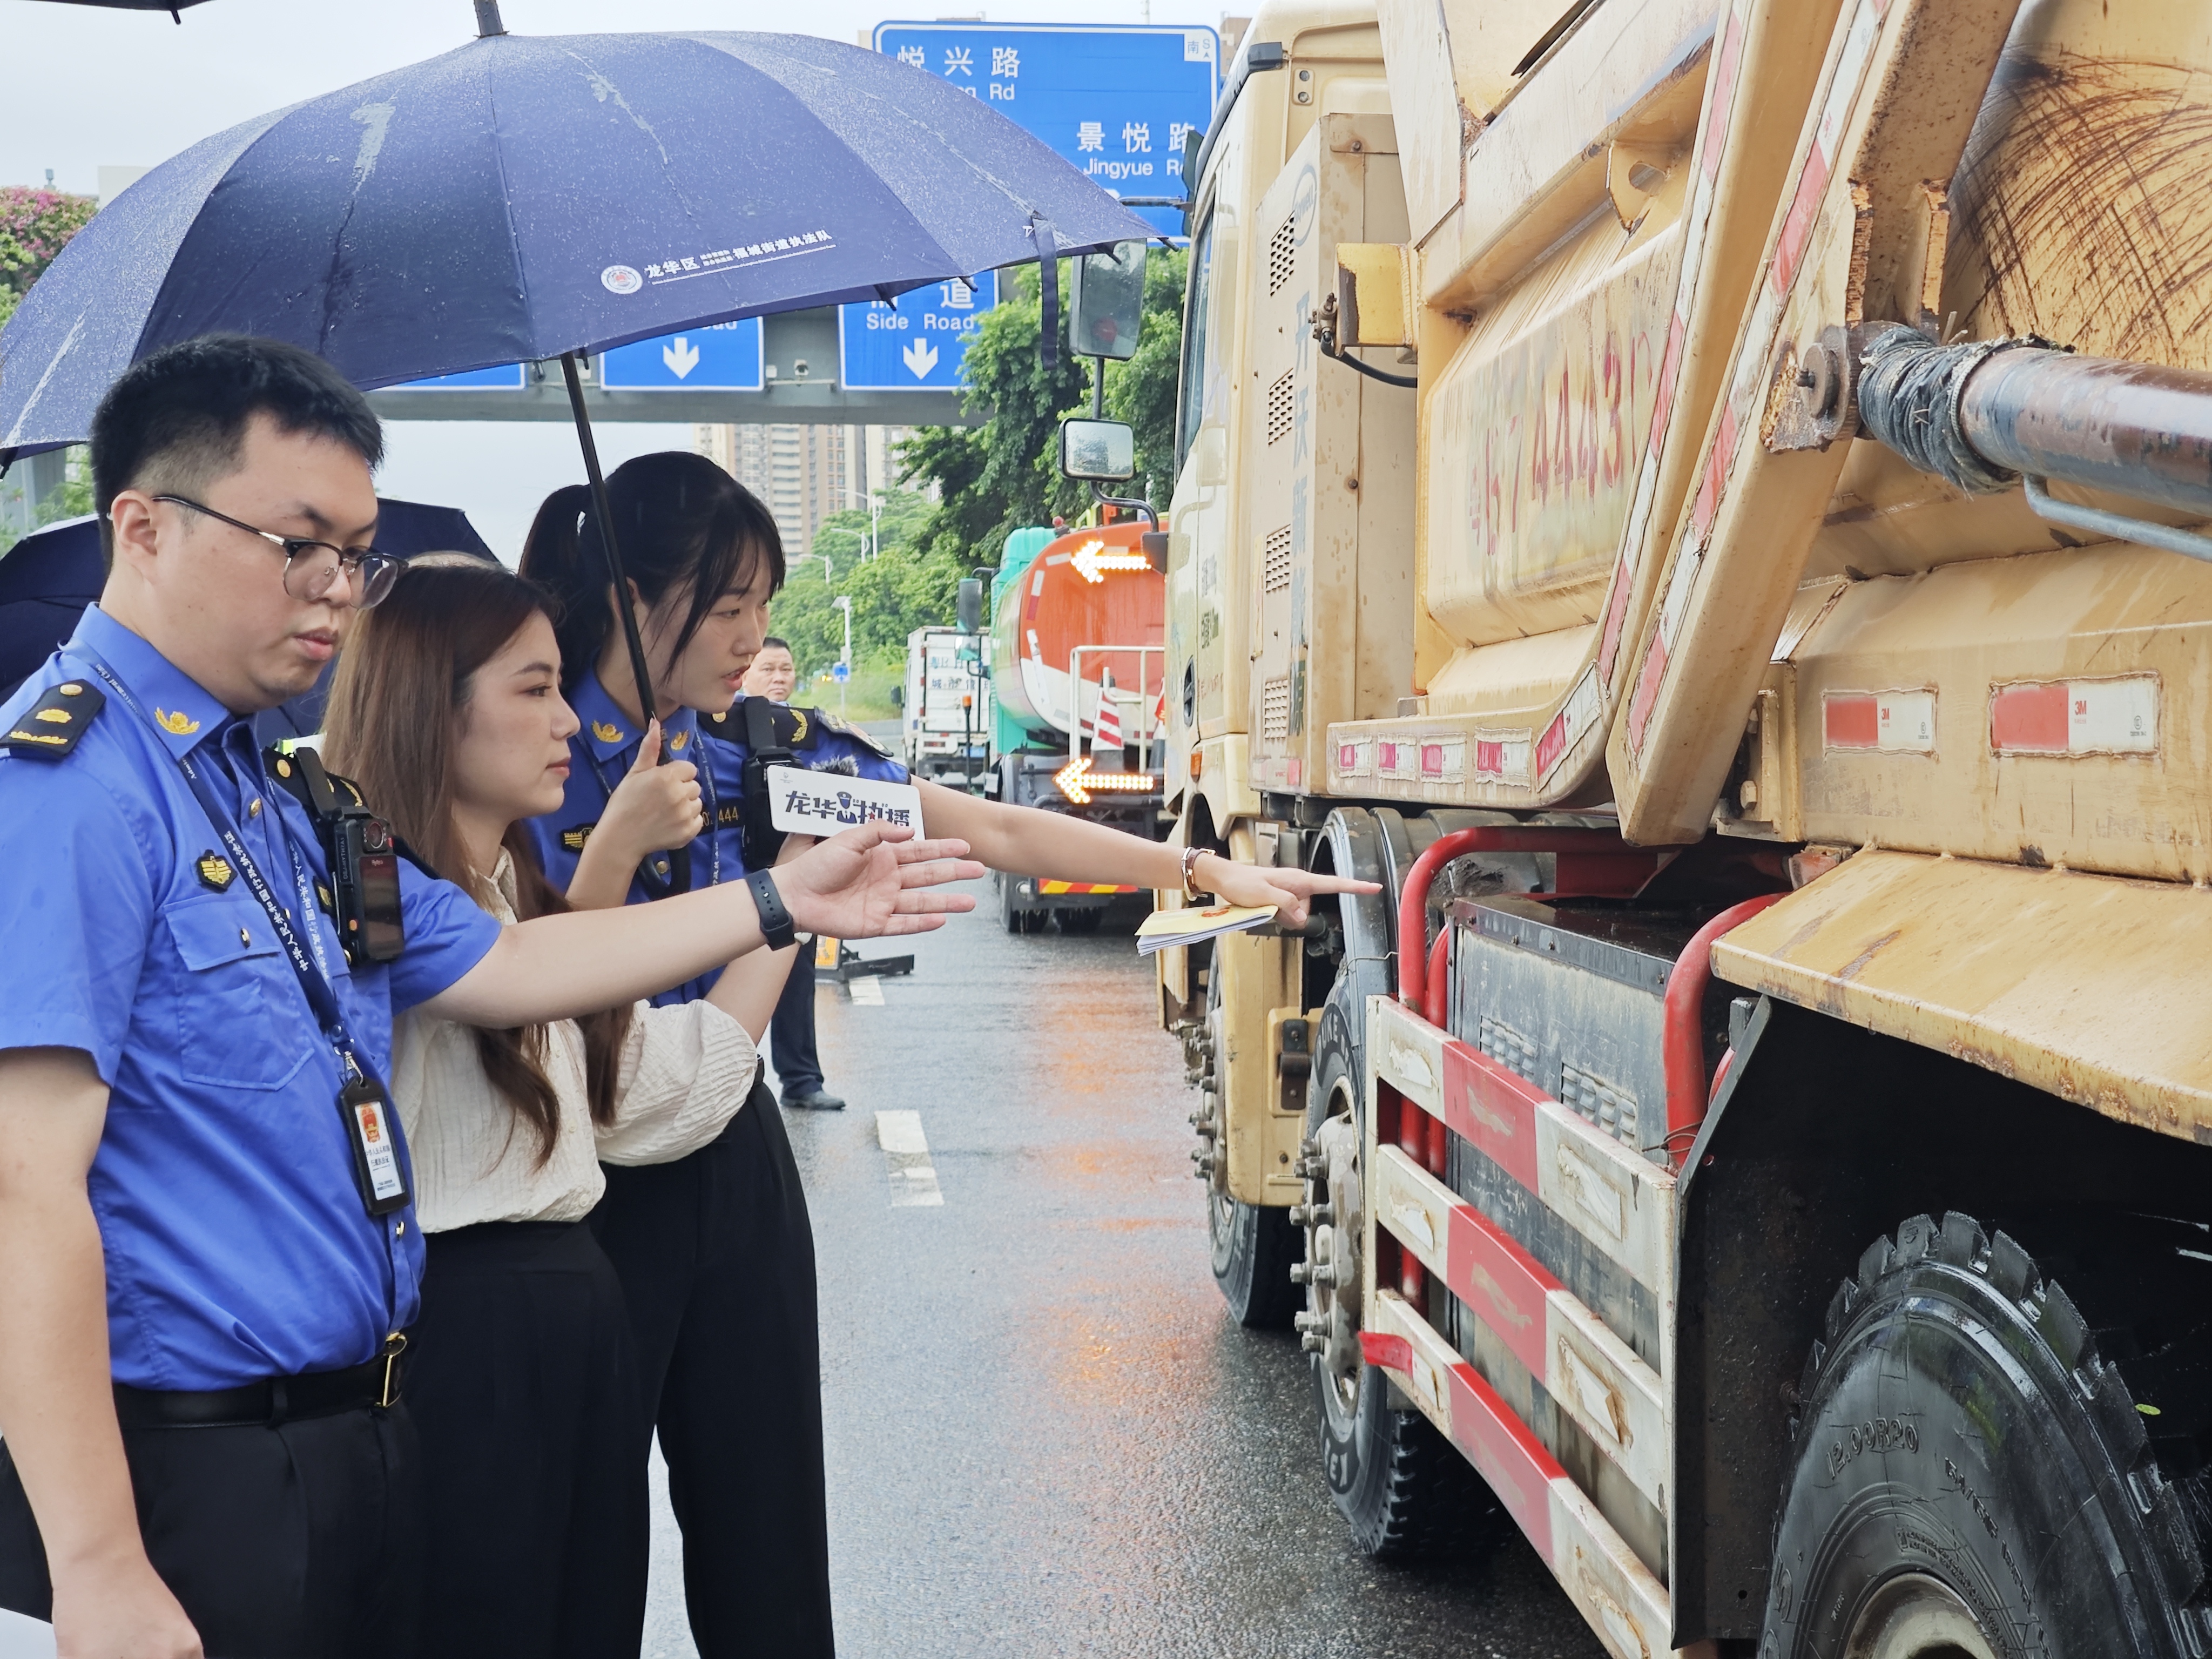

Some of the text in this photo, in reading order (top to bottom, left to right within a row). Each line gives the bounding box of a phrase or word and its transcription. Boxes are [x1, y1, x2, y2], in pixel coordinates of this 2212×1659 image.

[1188, 41, 1199, 55] 南
[1202, 38, 1211, 50] S
[897, 46, 1021, 78] 悦兴路
[990, 84, 1015, 100] Rd
[1077, 122, 1195, 153] 景悦路
[1083, 158, 1153, 179] Jingyue
[645, 256, 701, 279] 龙华区
[866, 313, 974, 330] Side Road
[1881, 708, 1889, 720] 3M
[2074, 700, 2086, 715] 3M
[224, 830, 309, 972] 中华人民共和国行政执法证
[1316, 1013, 1338, 1070] DUKE
[1826, 1418, 1919, 1480] 12.00R20
